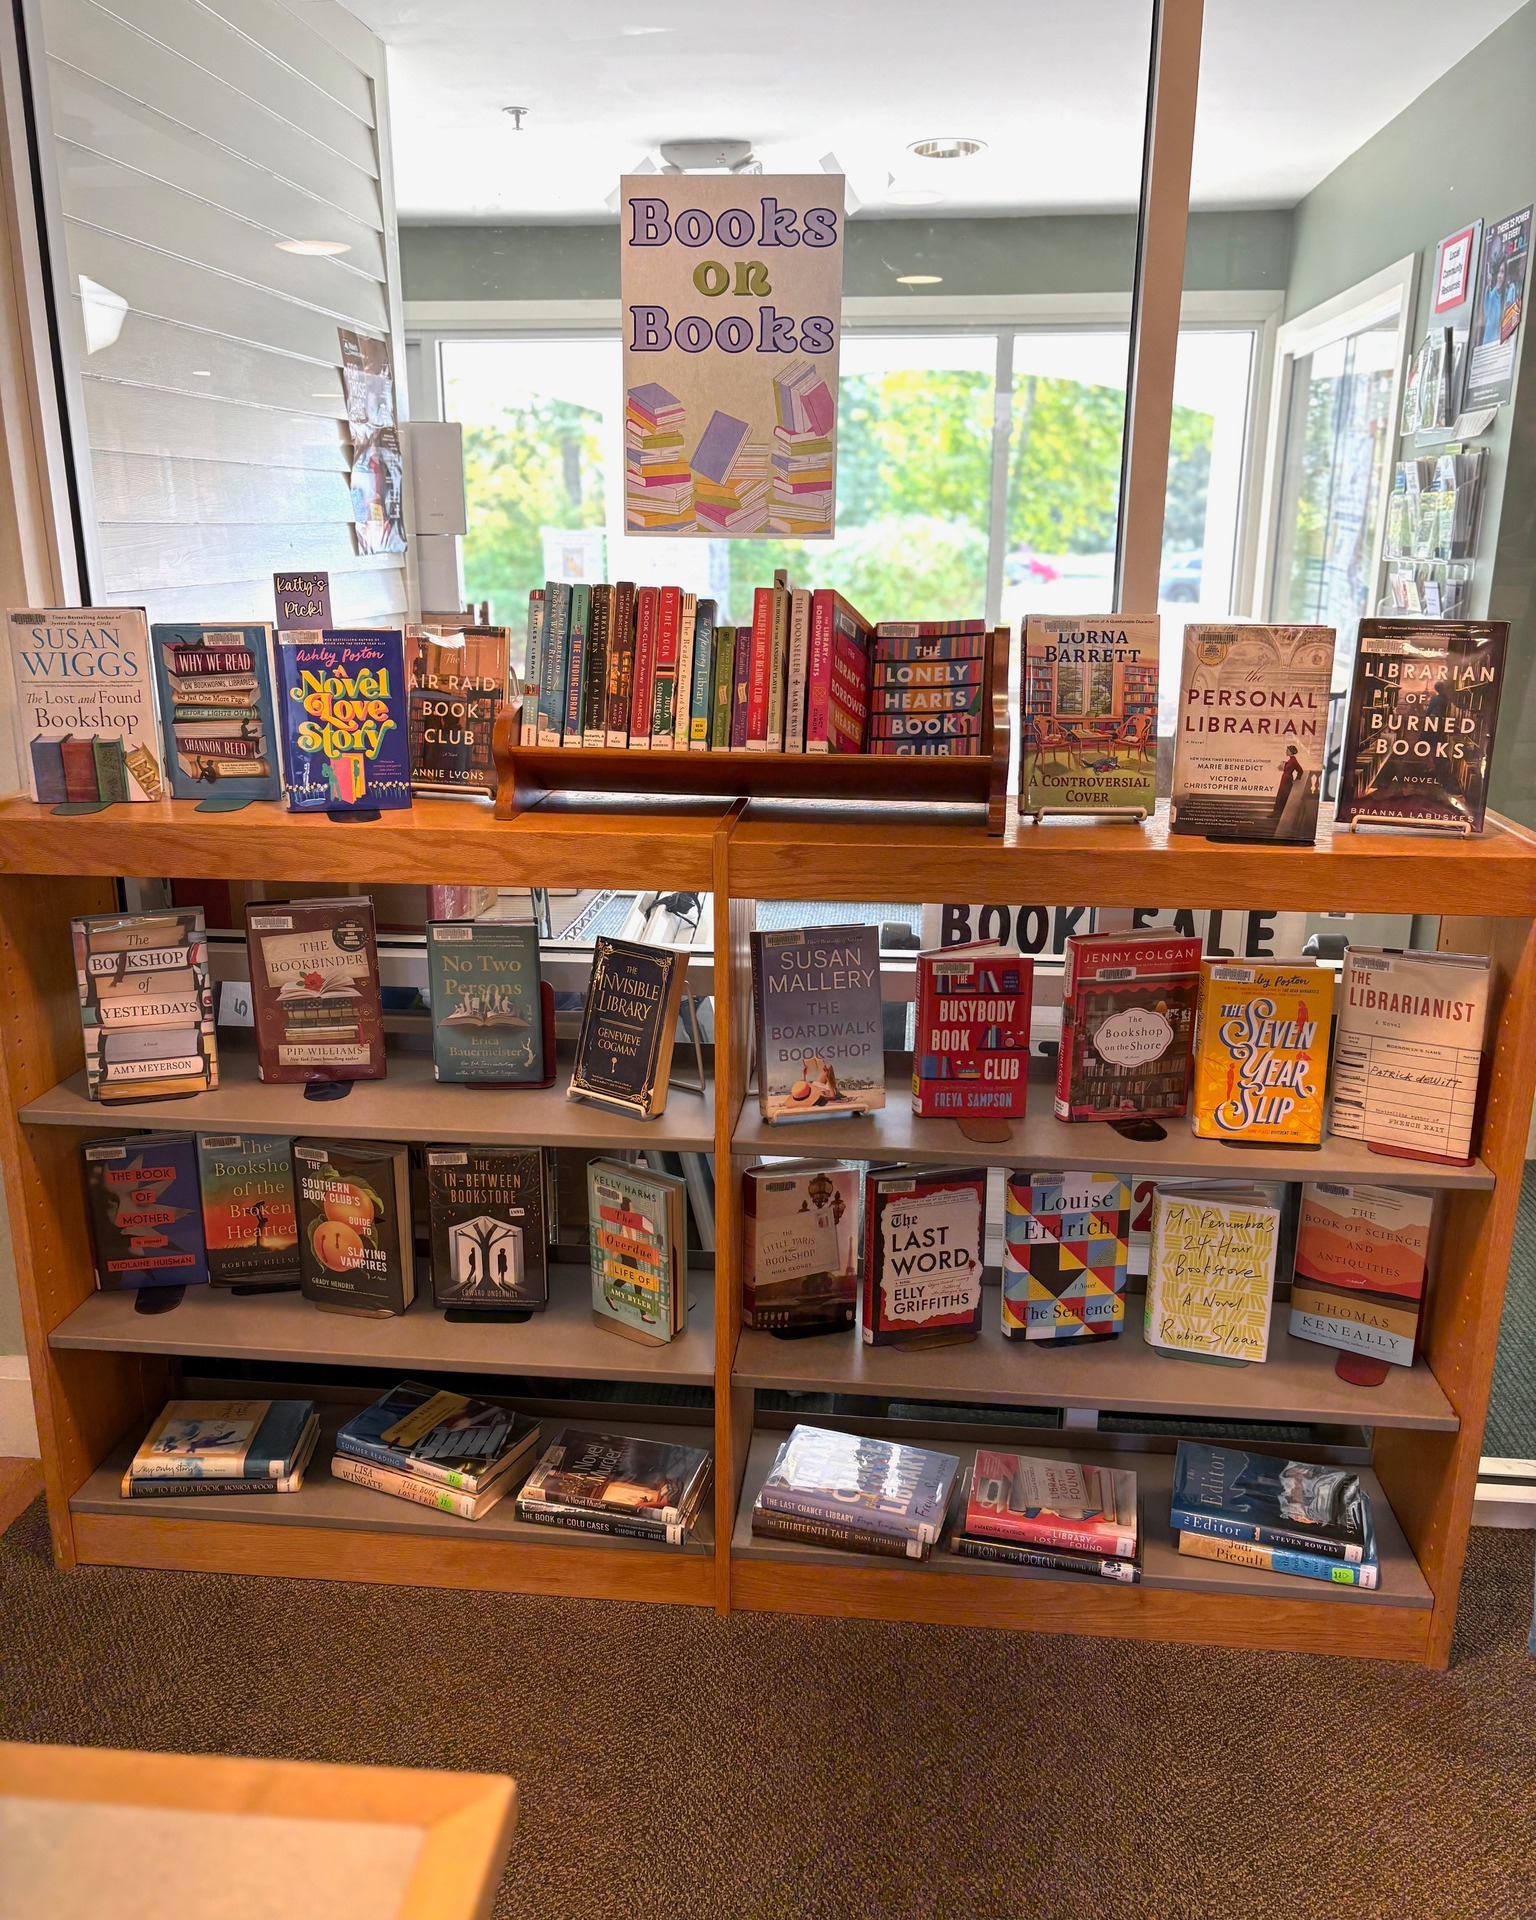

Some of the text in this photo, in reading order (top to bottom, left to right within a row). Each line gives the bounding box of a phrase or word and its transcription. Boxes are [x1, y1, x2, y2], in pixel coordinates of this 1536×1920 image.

[629, 198, 837, 248] Books
[1449, 247, 1460, 261] Local
[1507, 235, 1528, 255] GIRL
[692, 260, 772, 297] on
[1443, 262, 1463, 279] Community
[1441, 280, 1460, 296] Resources
[630, 305, 834, 353] Books
[276, 576, 327, 594] Kaity's
[284, 601, 323, 619] Pick!
[662, 593, 673, 657] BY THE BOOK
[32, 628, 119, 649] SUSAN
[793, 618, 802, 673] BOOKSELLER
[1057, 631, 1129, 644] LORNA
[296, 647, 384, 668] Ashley Poston
[915, 646, 940, 657] THE
[1044, 646, 1140, 663] BARRETT
[20, 652, 138, 677] WIGGS
[179, 653, 250, 672] WHY WE READ
[813, 648, 821, 676] HEARTS
[569, 640, 581, 720] THE LENDING LIBRARY
[886, 665, 968, 682] LONELY
[1365, 662, 1495, 682] LIBRARIAN
[289, 668, 392, 702] Novel
[410, 674, 495, 691] AIR RAID
[27, 690, 142, 704] The Lost and Found
[885, 691, 967, 709] HEARTS
[1188, 689, 1317, 709] PERSONAL
[1406, 694, 1427, 704] OF
[304, 692, 389, 731] Love
[422, 702, 479, 718] BOOK
[35, 707, 139, 734] Bookshop
[892, 718, 957, 735] BOOK
[1186, 716, 1317, 736] LIBRARIAN
[1371, 714, 1476, 734] BURNED
[298, 719, 397, 760] Story
[424, 729, 474, 745] CLUB
[1376, 739, 1465, 759] BOOKS
[1029, 775, 1150, 788] A CONTROVERSIAL
[1065, 790, 1109, 803] COVER
[941, 903, 1086, 954] BOOK
[127, 934, 149, 945] The
[300, 940, 329, 953] THE
[271, 954, 364, 973] BOOKBINDER
[441, 955, 521, 972] No Two
[780, 948, 861, 971] SUSAN
[1084, 949, 1194, 963] JENNY COLGAN
[138, 976, 152, 993] of
[444, 979, 522, 995] Persons
[599, 966, 660, 1000] INVISIBLE
[768, 969, 875, 994] MALLERY
[1351, 970, 1372, 985] THE
[102, 1002, 198, 1019] YESTERDAYS
[598, 991, 652, 1021] LIBRARY
[940, 1000, 1016, 1022] BUSYBODY
[1350, 987, 1476, 1022] LIBRARIANIST
[771, 1021, 876, 1040] BOARDWALK
[1105, 1027, 1163, 1038] Bookshop
[1219, 998, 1318, 1050] SEVEN
[932, 1030, 970, 1051] BOOK
[1130, 1041, 1162, 1050] Shore
[779, 1044, 871, 1062] BOOKSHOP
[984, 1058, 1019, 1080] CLUB
[1230, 1043, 1318, 1098] YEAR
[1214, 1082, 1294, 1131] SLIP
[241, 1140, 272, 1154] The
[111, 1169, 171, 1181] THE BOOK
[444, 1173, 521, 1189] IN-BETWEEN
[233, 1180, 285, 1197] of the
[302, 1178, 349, 1194] SOUTHERN
[135, 1193, 152, 1202] OF
[303, 1190, 360, 1207] BOOK CLUB'S
[451, 1190, 516, 1205] BOOKSTORE
[1040, 1190, 1113, 1211] Louise
[123, 1213, 170, 1225] MOTHER
[230, 1203, 291, 1218] Broken
[615, 1211, 634, 1224] The
[1166, 1209, 1274, 1231] Mr. Penumbra's
[227, 1220, 297, 1240] Hearted
[891, 1213, 918, 1229] The
[1023, 1217, 1110, 1240] Erdrich
[1306, 1214, 1421, 1247] BOOK OF SCIENCE
[606, 1235, 652, 1259] Overdue
[892, 1226, 949, 1253] LAST
[1184, 1236, 1252, 1259] 24-Hour
[347, 1247, 387, 1261] SLAYING
[891, 1249, 970, 1277] WORD
[340, 1256, 387, 1272] VAMPIRES
[1176, 1254, 1261, 1278] Bookstore
[1317, 1252, 1400, 1277] ANTIQUITIES
[614, 1266, 651, 1286] LIFE OF
[1020, 1302, 1119, 1321] The Sentence
[1315, 1301, 1389, 1327] THOMAS
[1160, 1318, 1258, 1346] Robin Sloan
[1302, 1316, 1399, 1349] KENEALLY
[342, 1442, 400, 1466] SUMMER READING
[197, 1484, 219, 1492] BOOK
[570, 1496, 585, 1506] Novel
[586, 1499, 606, 1509] Murder
[766, 1498, 854, 1523] THE LAST CHANCE LIBRARY
[535, 1513, 555, 1523] BOOK
[567, 1519, 585, 1528] COLD
[586, 1521, 609, 1531] CASES
[778, 1521, 849, 1539] THIRTEENTH TALE
[1053, 1531, 1092, 1543] LIBRARY
[1193, 1516, 1339, 1553] Editor STEVEN ROWLEY
[1070, 1541, 1102, 1552] FOUND
